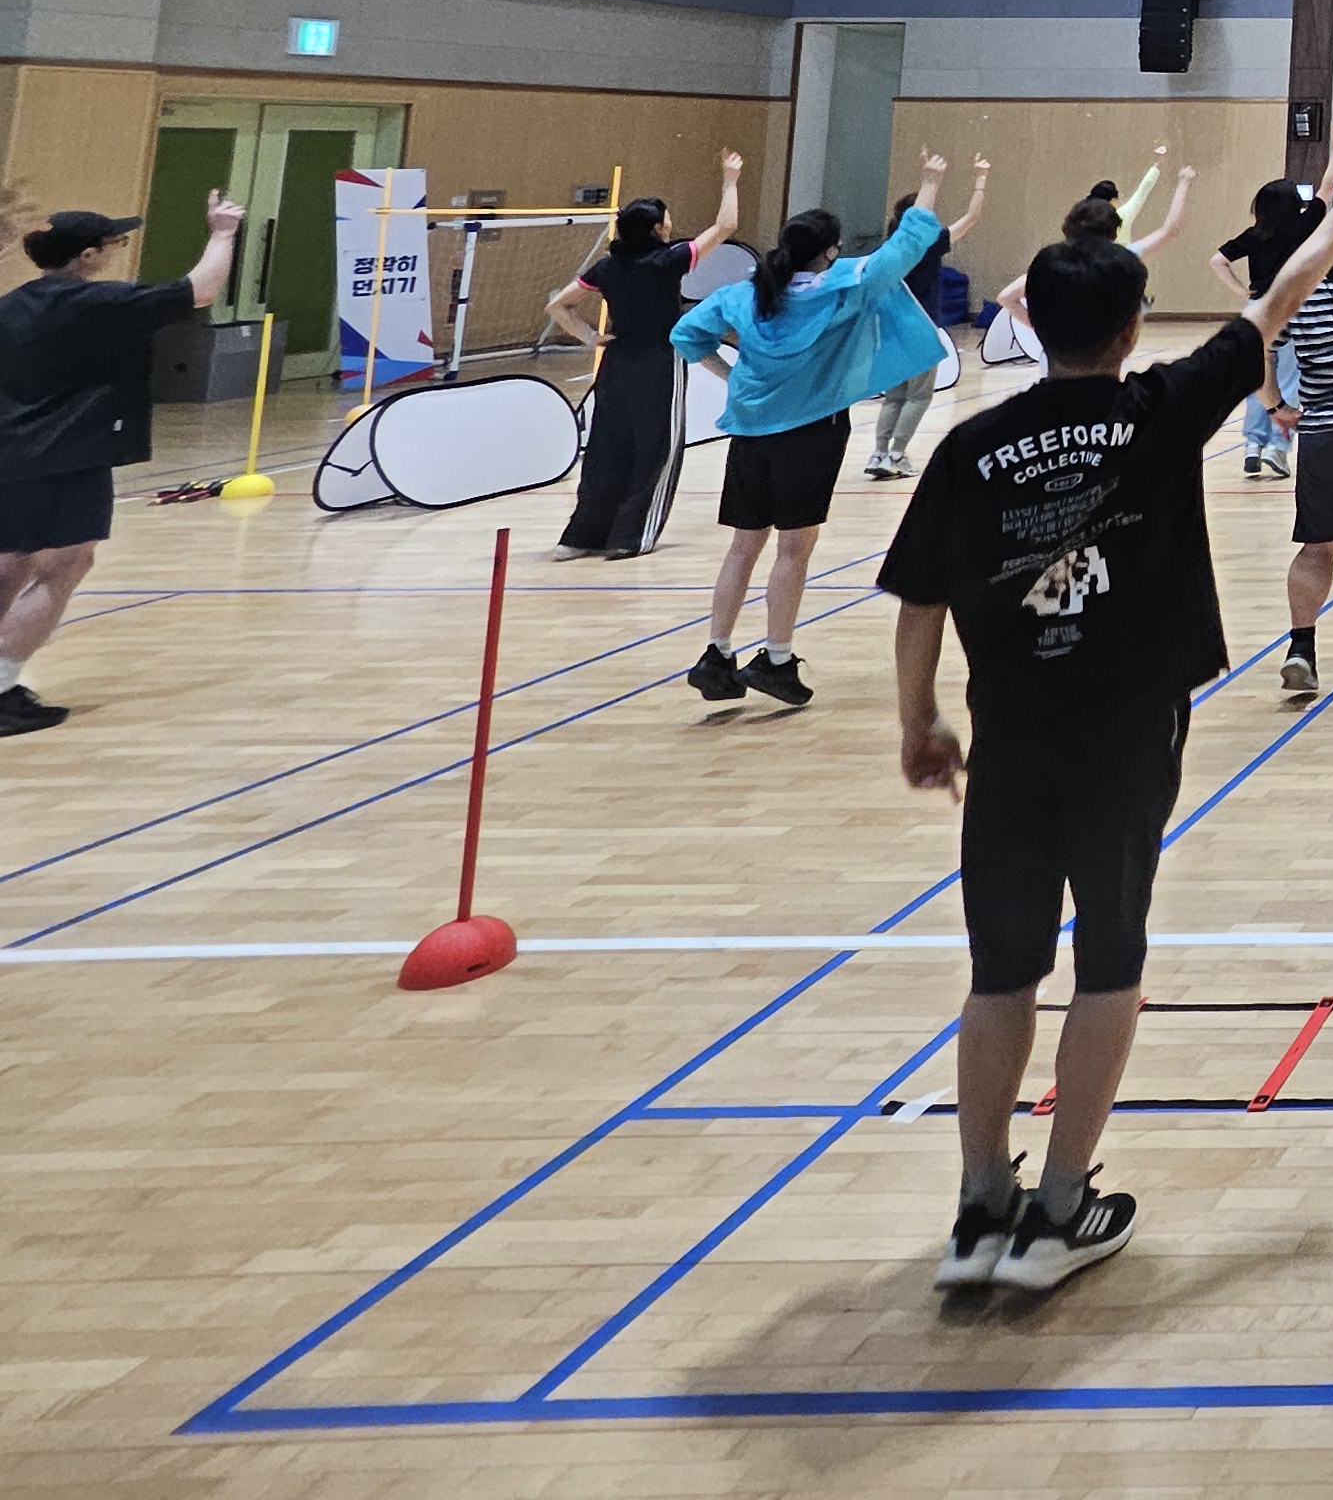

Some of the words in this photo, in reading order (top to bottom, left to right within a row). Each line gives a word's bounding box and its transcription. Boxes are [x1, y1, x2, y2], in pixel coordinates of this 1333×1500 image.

[353, 255, 418, 275] 정확히
[352, 277, 417, 297] 던지기
[977, 422, 1135, 482] FREEFORM
[1013, 451, 1103, 485] COLLECTIVE
